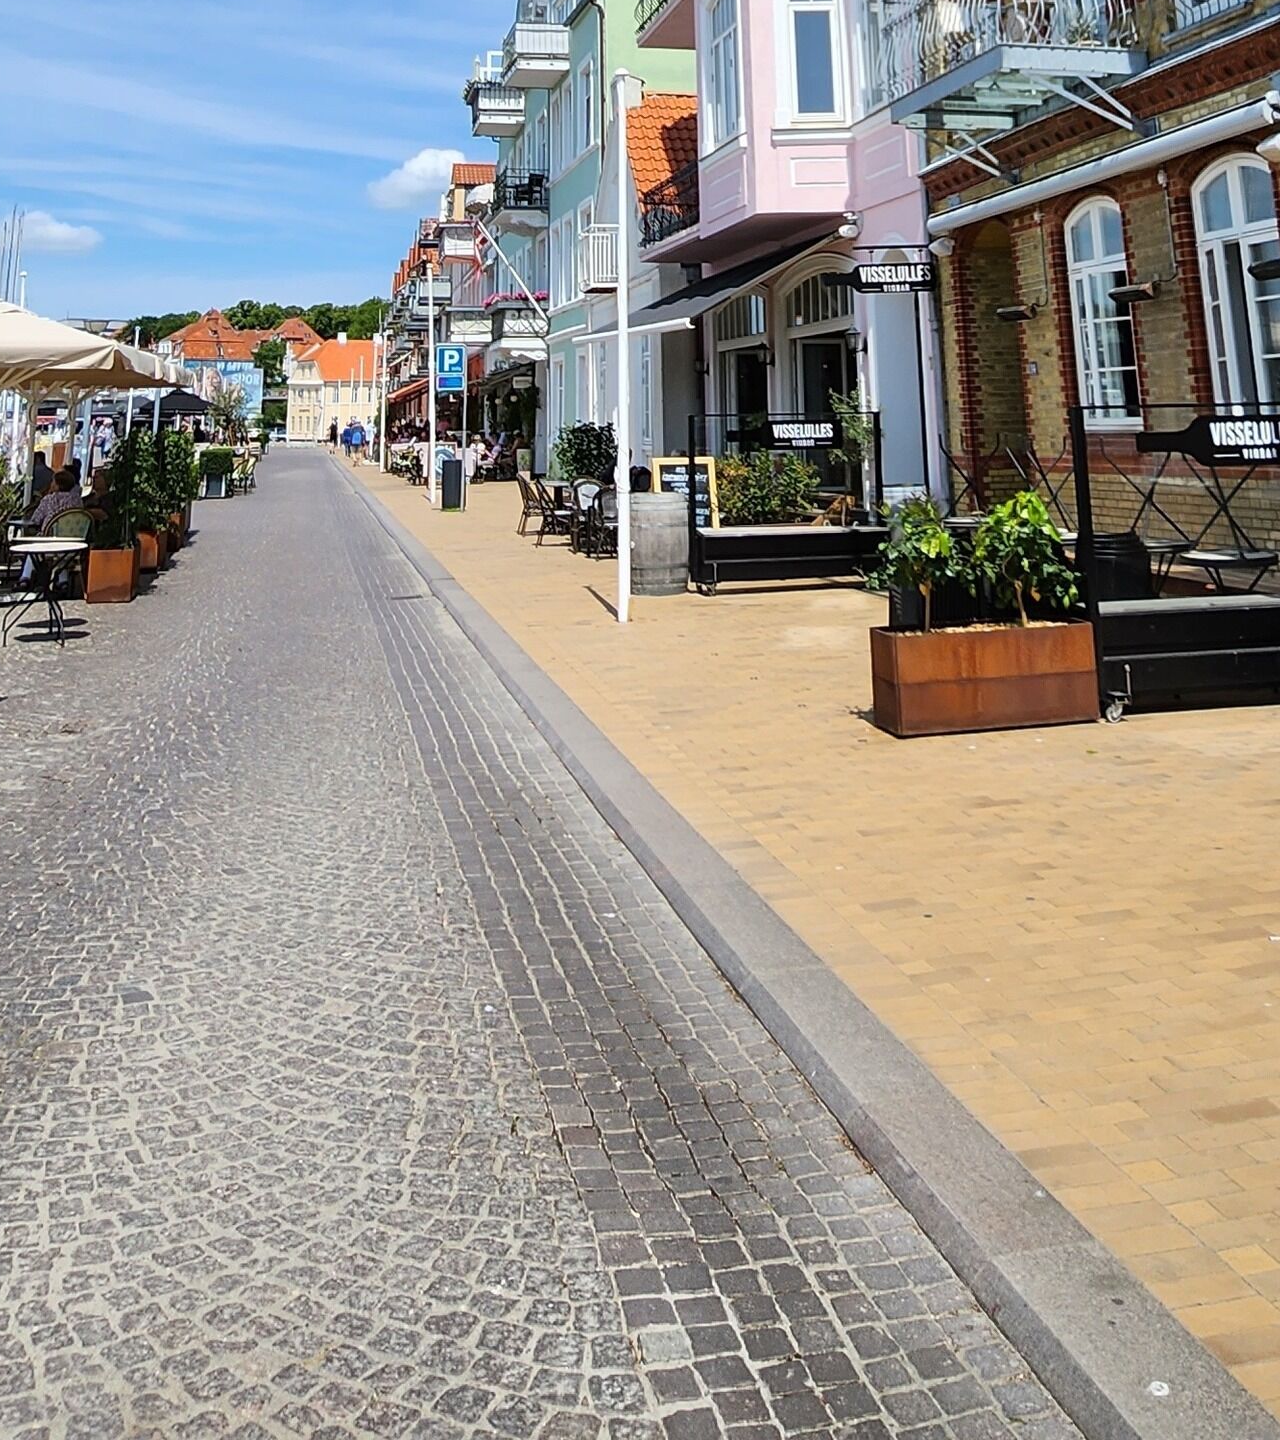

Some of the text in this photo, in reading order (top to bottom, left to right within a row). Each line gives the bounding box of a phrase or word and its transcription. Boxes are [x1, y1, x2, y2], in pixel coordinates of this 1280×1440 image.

[858, 265, 931, 283] VISSELULLES
[443, 350, 460, 372] P
[772, 423, 834, 439] VISSELULLES
